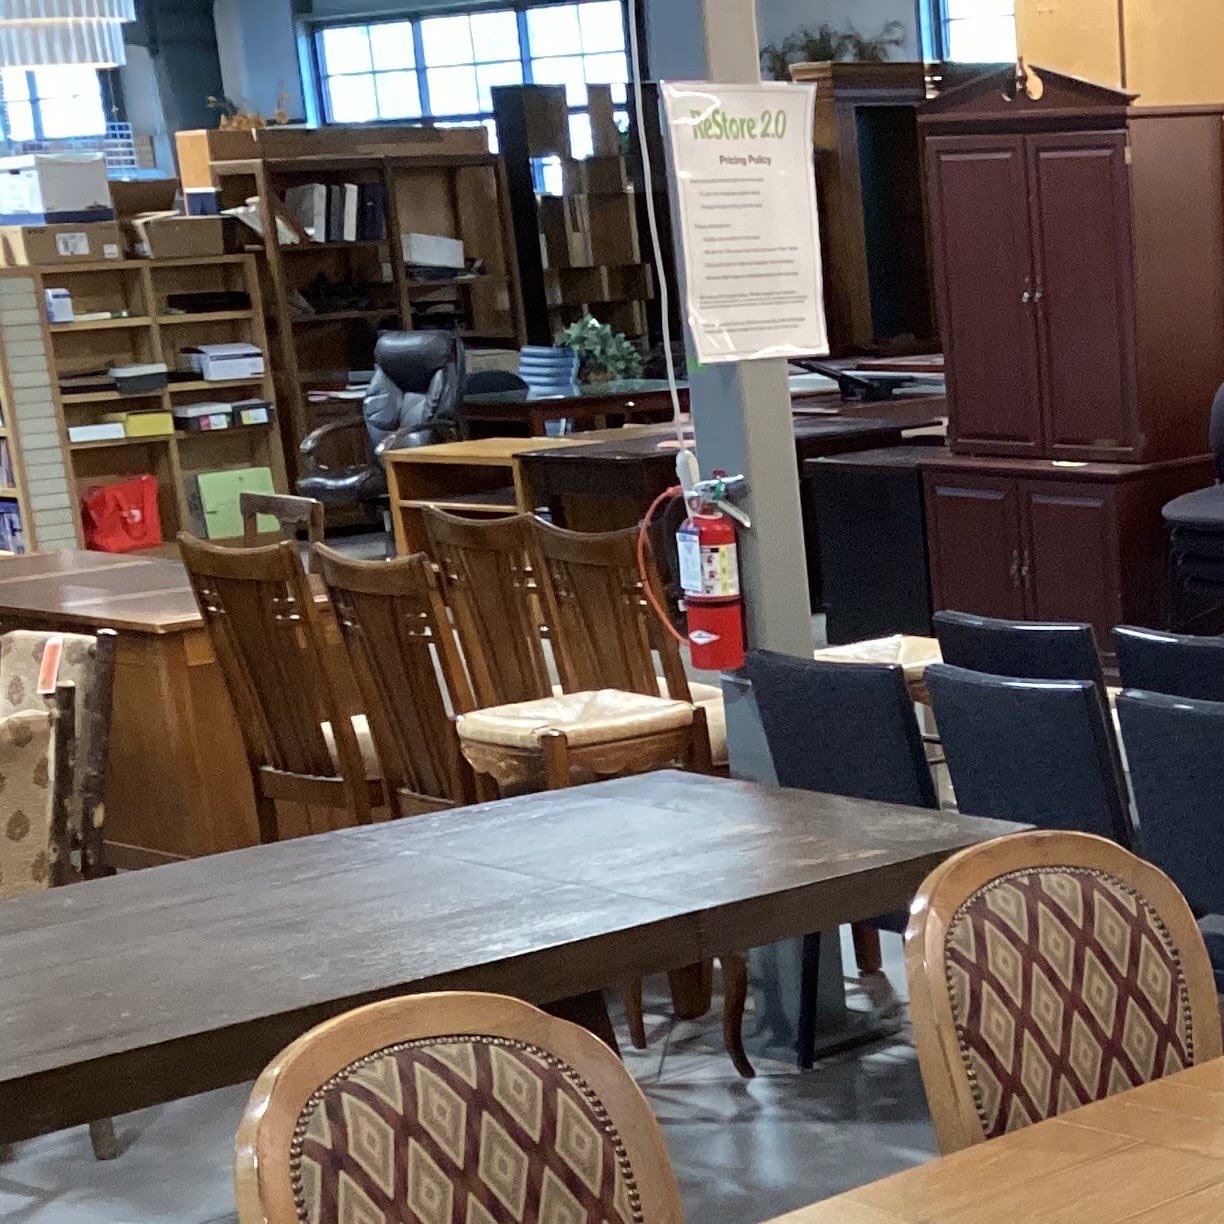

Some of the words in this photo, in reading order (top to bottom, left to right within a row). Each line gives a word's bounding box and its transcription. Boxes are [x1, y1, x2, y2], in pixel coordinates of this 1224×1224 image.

[759, 109, 787, 139] 2.0
[719, 154, 747, 167] Pricing
[747, 154, 772, 166] Policy
